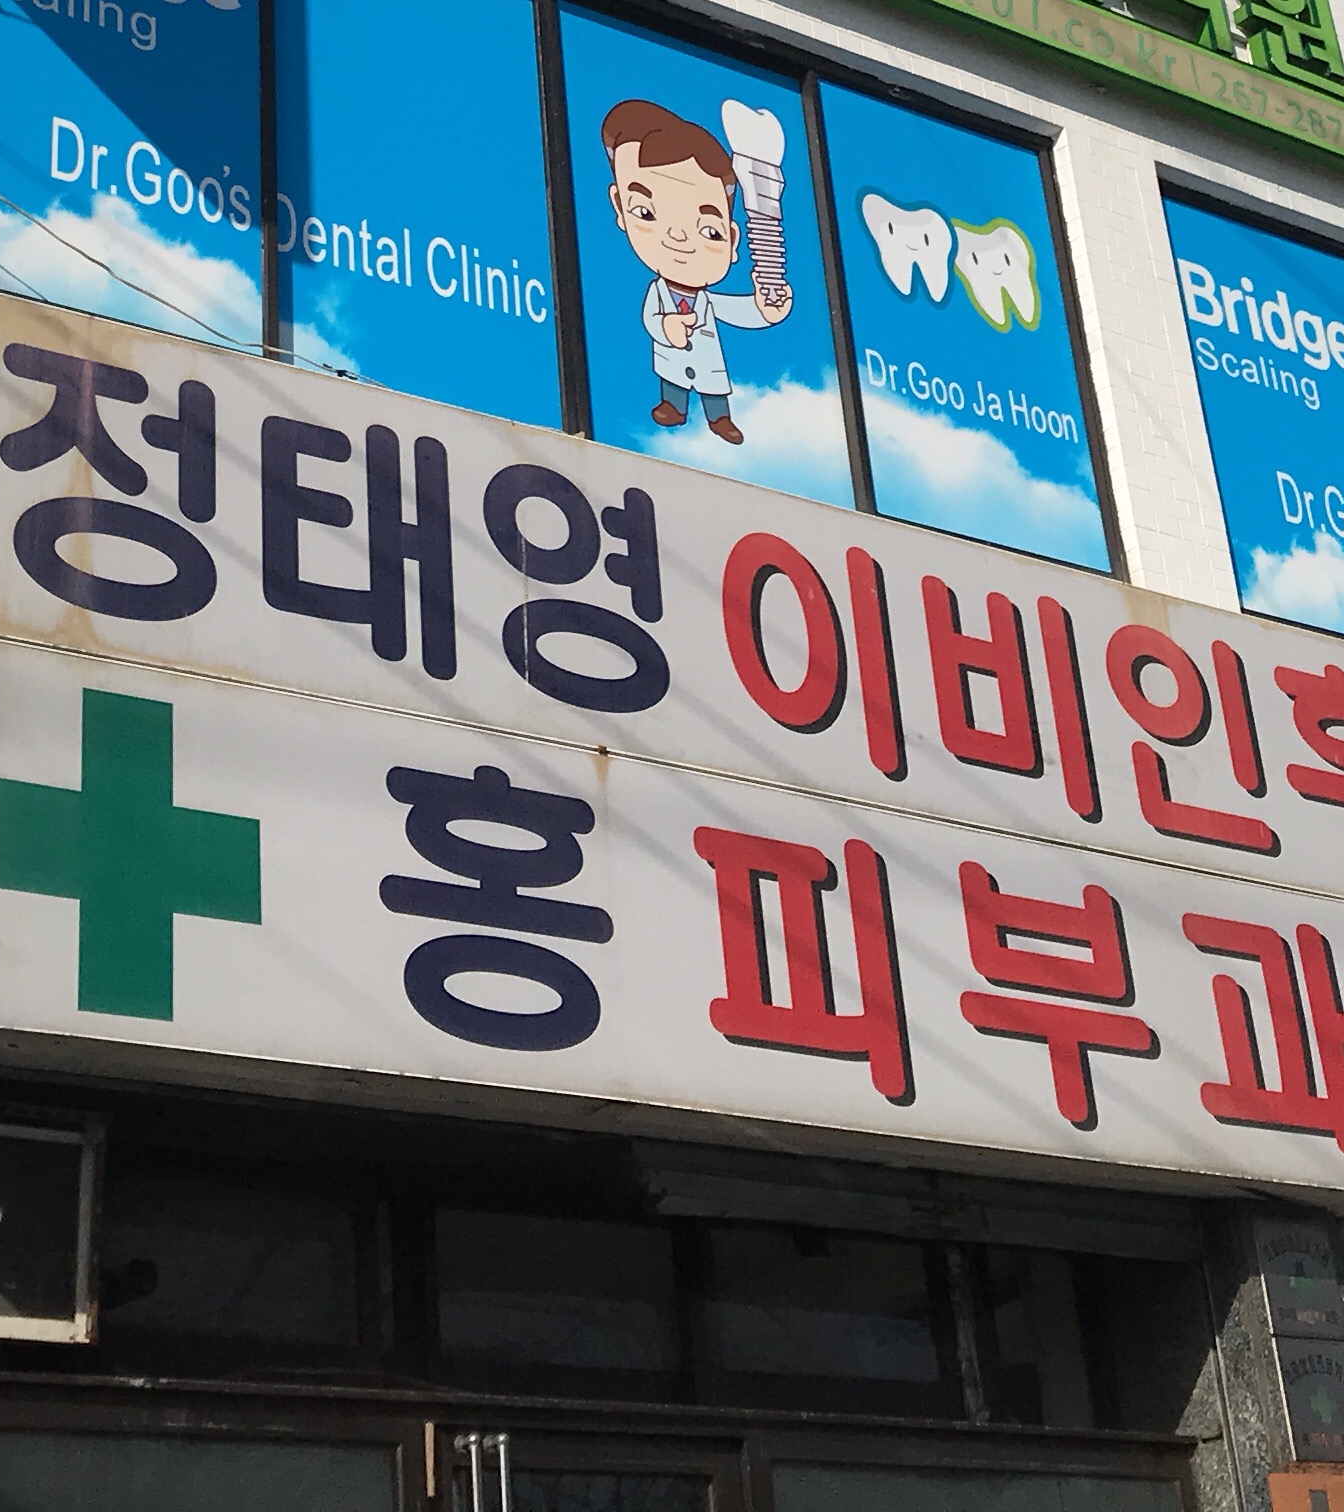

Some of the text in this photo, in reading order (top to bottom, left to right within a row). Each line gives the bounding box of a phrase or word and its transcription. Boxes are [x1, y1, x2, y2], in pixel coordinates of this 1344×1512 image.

[425, 235, 548, 325] Clinic
[1195, 337, 1322, 411] Scaling
[972, 393, 1005, 423] Ja
[1009, 400, 1079, 445] Hoon
